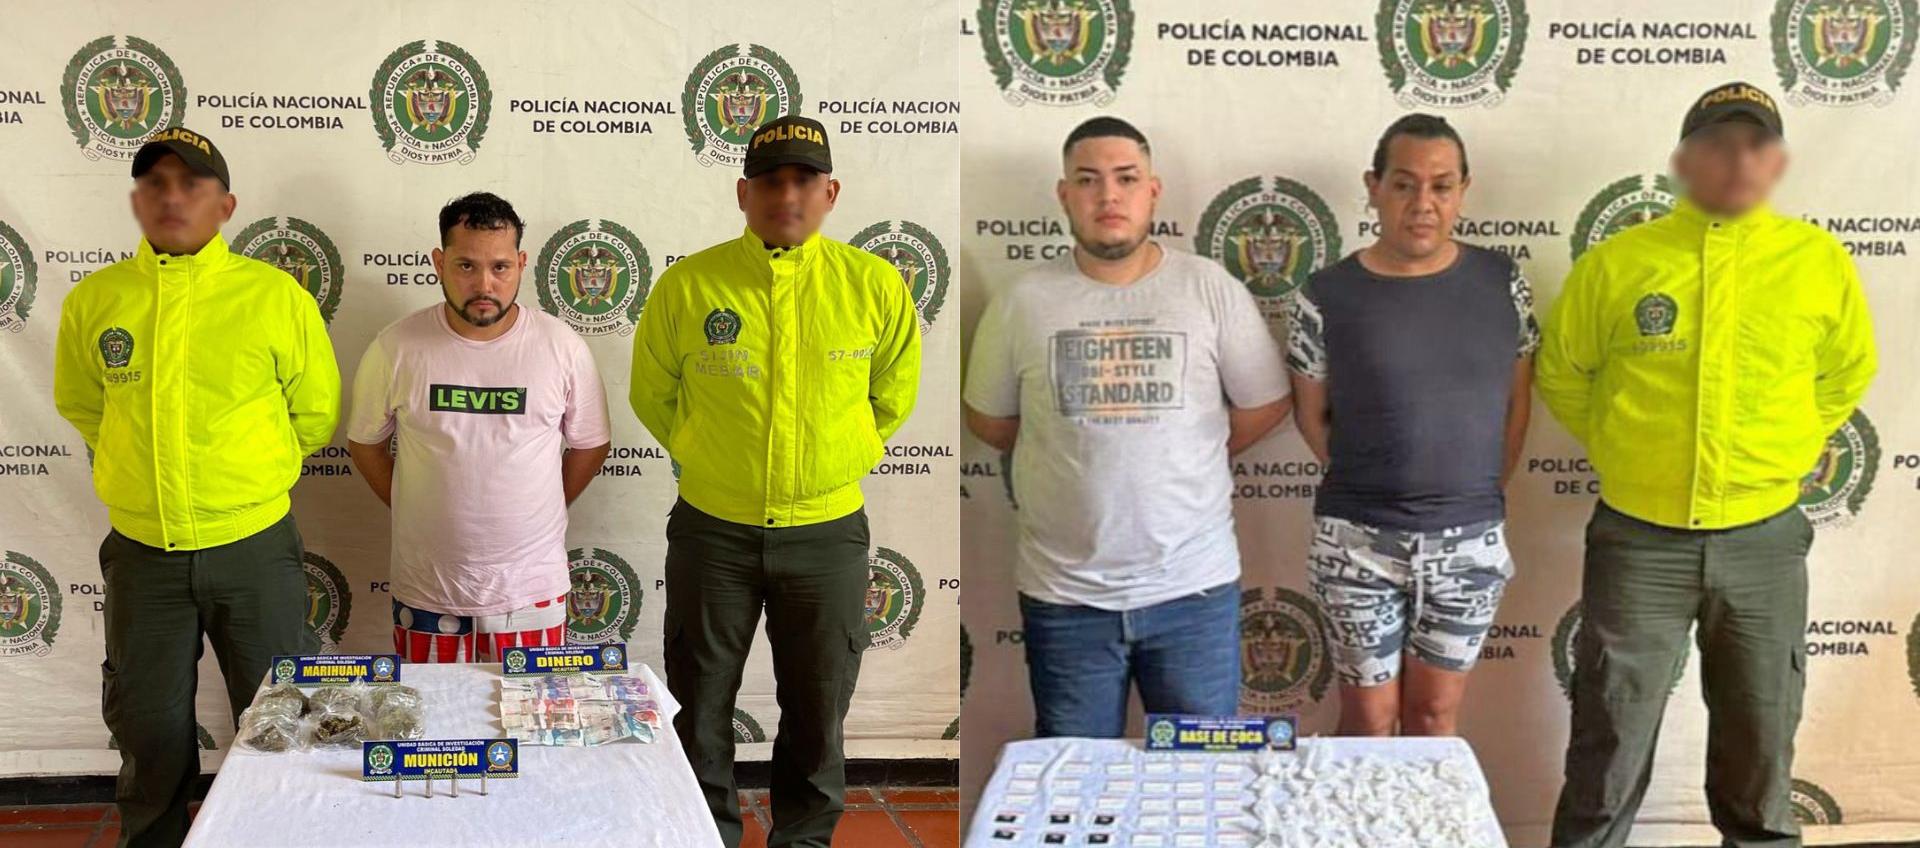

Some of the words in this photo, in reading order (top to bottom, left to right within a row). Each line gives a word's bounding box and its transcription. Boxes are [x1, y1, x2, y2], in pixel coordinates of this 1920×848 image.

[1158, 19, 1245, 40] POLICÍA
[1252, 24, 1369, 41] NACIONAL
[1549, 18, 1636, 39] POLICÍA
[1642, 22, 1757, 39] NACIONAL
[1187, 50, 1216, 66] DE
[1222, 50, 1339, 67] COLOMBIA
[1577, 48, 1606, 64] DE
[1611, 48, 1727, 64] COLOMBIA
[116, 50, 130, 58] DE
[140, 55, 171, 106] COLOMBIA
[448, 60, 477, 110] COLOMBIA
[738, 58, 751, 66] DE
[761, 63, 787, 114] COLOMBIA
[197, 92, 268, 108] POLICÍA
[273, 96, 367, 109] NACIONAL
[510, 97, 579, 113] POLICÍA
[585, 101, 676, 114] NACIONAL
[818, 97, 887, 114] POLICÍA
[892, 101, 960, 114] NACION
[222, 116, 244, 128] DE
[250, 116, 344, 129] COLOMBIA
[533, 121, 555, 133] DE
[560, 121, 652, 134] COLOMBIA
[840, 121, 862, 134] DE
[868, 121, 959, 134] COLOMBIA
[432, 121, 473, 150] NACIONAL
[754, 125, 825, 149] POLICIA
[432, 148, 462, 161] PATRIA
[977, 216, 1063, 236] POLICÍA
[46, 248, 116, 263] POLICÍA
[301, 236, 329, 284] COLOMBIA
[364, 250, 431, 266] POLICÍA
[611, 238, 638, 285] COLOMBIA
[1007, 245, 1034, 260] DE
[911, 239, 935, 285] COLOMBIA
[387, 274, 408, 285] DE
[593, 294, 634, 322] NACIONAL
[592, 320, 623, 334] PATRIA
[1064, 337, 1172, 360] EIGHTEEN
[1064, 382, 1173, 404] STANDARD
[1555, 481, 1580, 494] DE
[20, 567, 49, 611] COLOMBIA
[310, 567, 338, 609] COLOMBIA
[604, 564, 629, 607] COLOMBIA
[887, 563, 911, 606] COLOMBIA
[9, 620, 46, 644] NACIONAL
[587, 615, 625, 640] NACIONAL
[10, 642, 39, 655] PATRIA
[536, 655, 594, 668] DINERO
[303, 665, 368, 677] MARIHUANA
[1180, 730, 1210, 743] BASE
[1212, 730, 1227, 743] DE
[1229, 730, 1264, 743] COCA
[404, 751, 478, 768] MUNICIÓN
